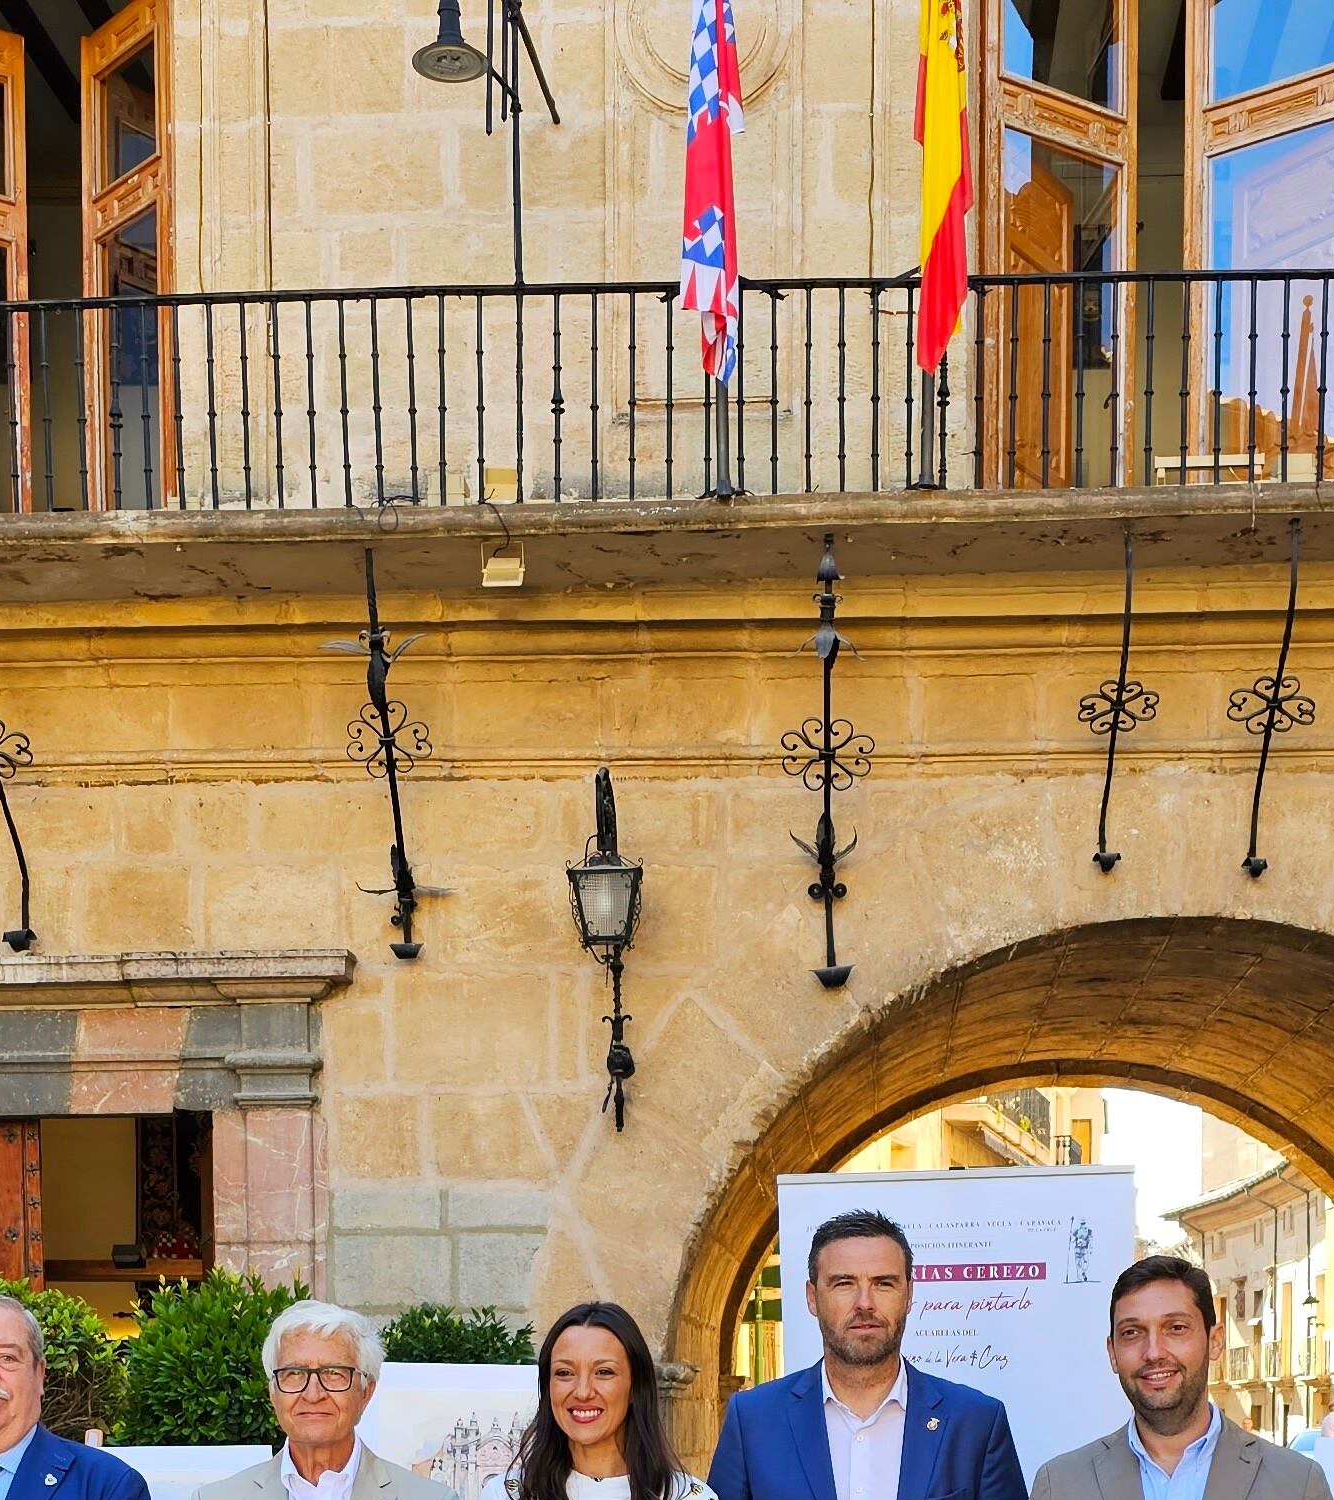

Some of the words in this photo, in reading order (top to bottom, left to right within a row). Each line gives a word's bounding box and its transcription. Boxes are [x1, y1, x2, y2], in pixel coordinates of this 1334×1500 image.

[962, 1264, 1040, 1279] CEREZO
[919, 1299, 964, 1320] para
[966, 1286, 1033, 1320] pintarlo
[945, 1344, 968, 1368] Vera
[978, 1345, 1008, 1370] Cruz
